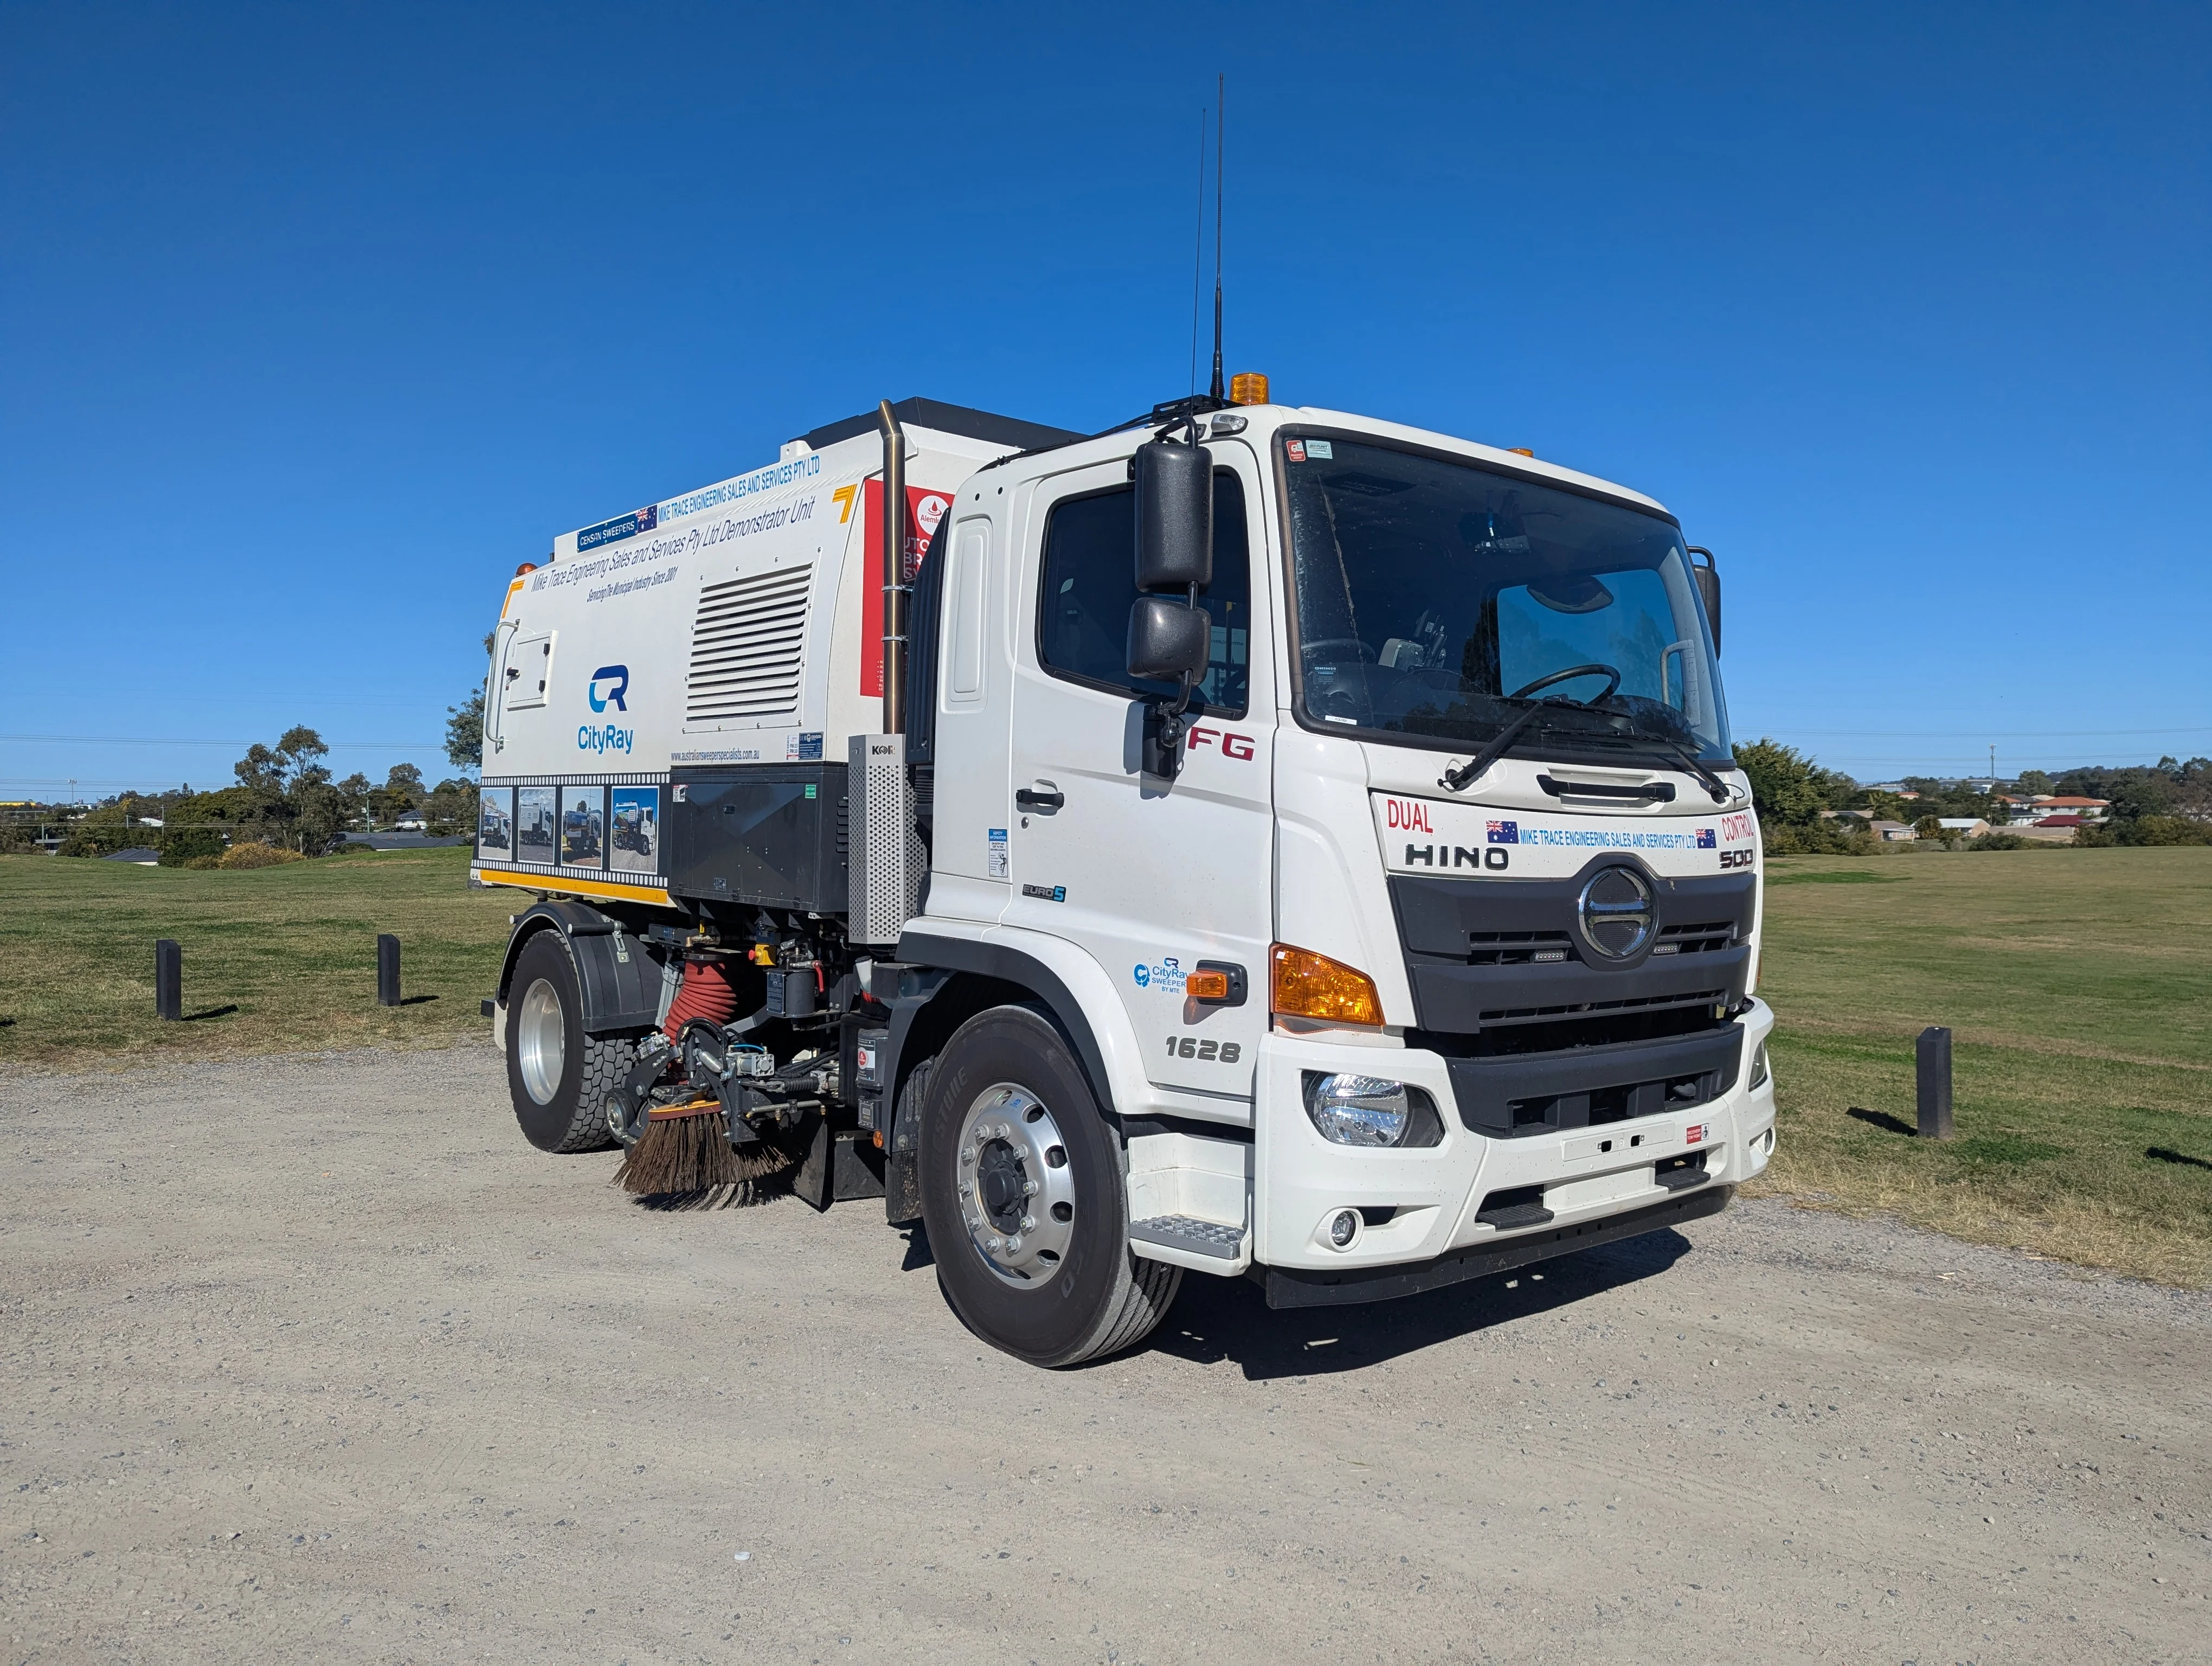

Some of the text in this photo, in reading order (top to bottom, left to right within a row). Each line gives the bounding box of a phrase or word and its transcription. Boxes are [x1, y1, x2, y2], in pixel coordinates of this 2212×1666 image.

[659, 456, 820, 522] MIKE TRACE ENGINEERING SALES AND SERVICES PTY LTD
[531, 495, 816, 592] Mike Trace Engineering Sales and Services Pty Ltd Demonstrator Unit
[603, 521, 635, 539] SWEEPERS
[587, 586, 606, 603] Servicing
[632, 575, 653, 591] Industry
[651, 571, 666, 586] Since
[664, 565, 678, 583] 2001
[578, 725, 633, 754] CityRay
[1188, 727, 1255, 761] FG
[671, 748, 760, 763] www.australiansweeperspecialists.com.au
[1387, 799, 1433, 833] DUAL
[1721, 814, 1754, 842] CONTROL
[1520, 829, 1696, 848] MIKE TRACE ENGINEERING SALES AND SERVICES PTY LTD
[1405, 843, 1509, 871] HINO
[1719, 849, 1753, 869] 500
[1152, 977, 1187, 987] SWEEPER
[1166, 1036, 1241, 1063] 1628
